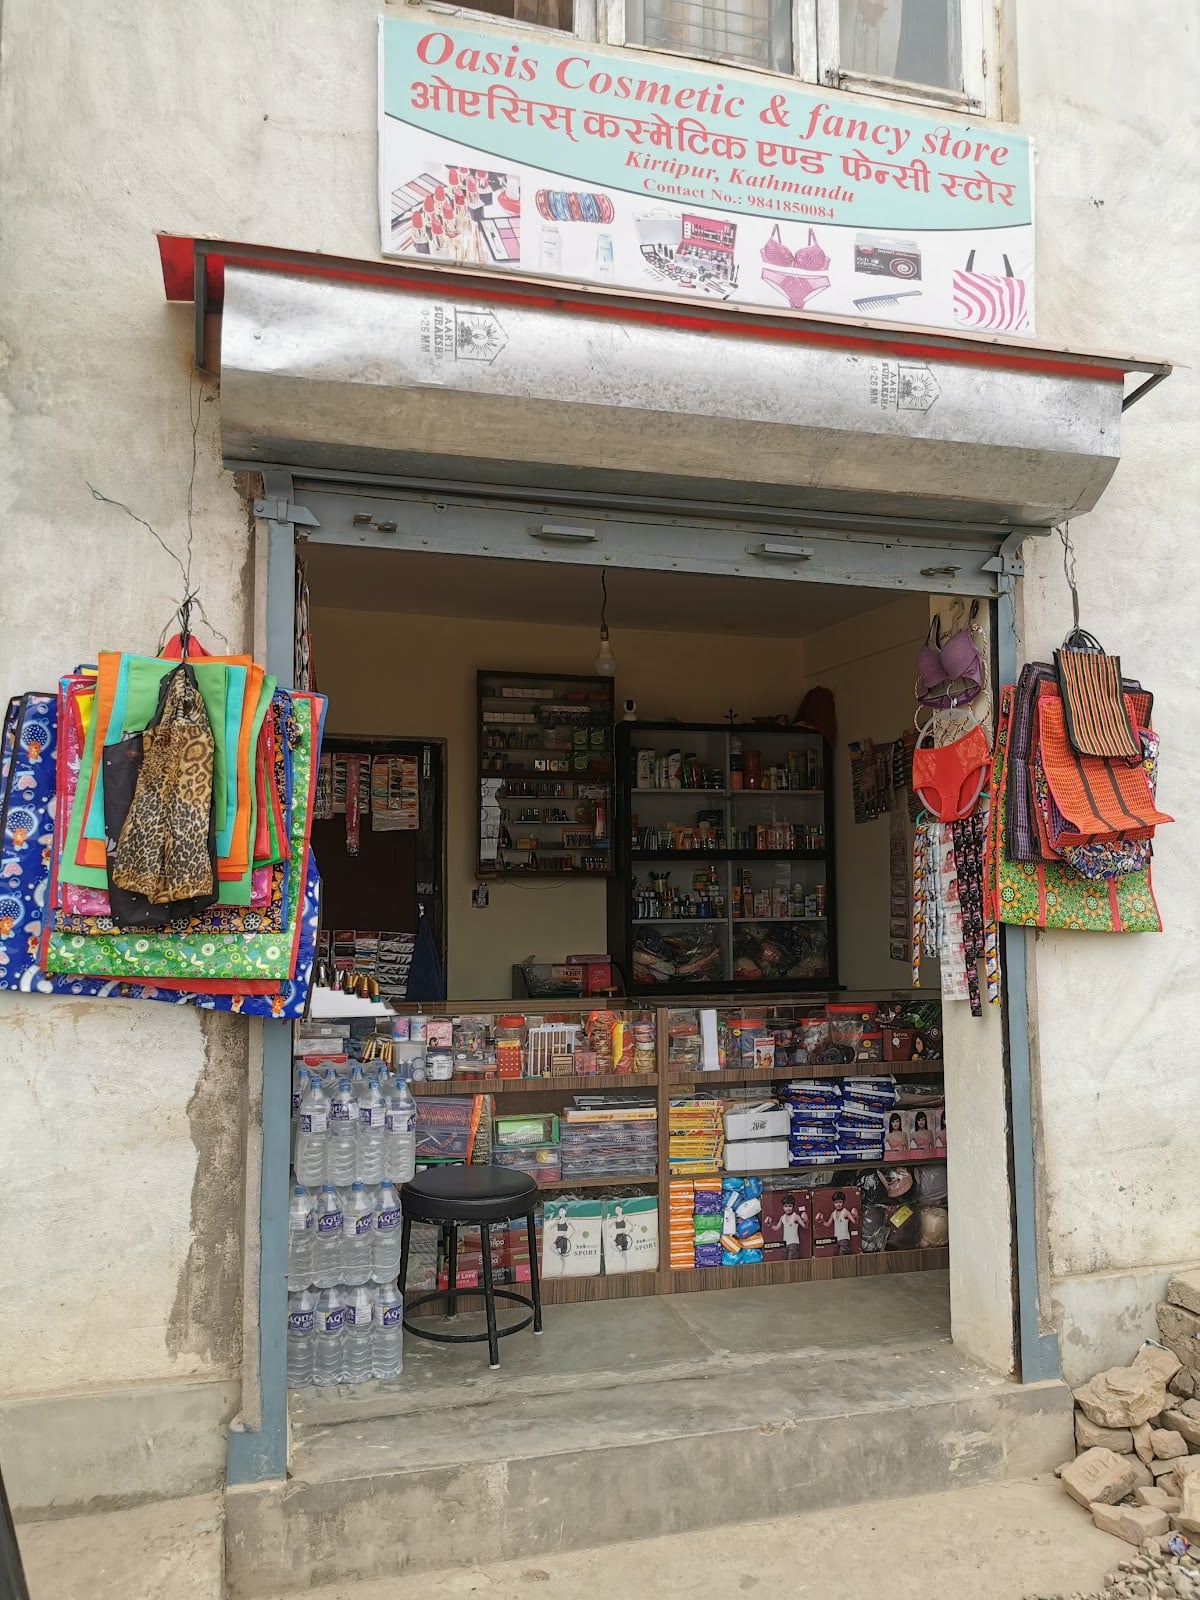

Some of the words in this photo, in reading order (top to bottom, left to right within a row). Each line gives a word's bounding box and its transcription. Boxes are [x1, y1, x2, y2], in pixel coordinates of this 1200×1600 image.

[416, 32, 539, 82] Oasis
[555, 56, 745, 119] Cosmetic
[759, 93, 792, 128] &
[799, 103, 911, 156] fancy
[921, 126, 1009, 166] store
[410, 74, 579, 142] ओएसिस्
[583, 112, 748, 161] कस्मेटिक
[756, 140, 832, 175] एण्ड
[840, 148, 931, 194] फेन्सी
[938, 169, 1017, 207] स्टोर
[624, 150, 720, 184] Kirtipur,
[728, 167, 856, 203] Kathmandu
[643, 177, 705, 199] Contact
[711, 188, 742, 205] No.:
[747, 195, 835, 219] 9841850084
[434, 305, 444, 360] SURAKSHA
[444, 316, 454, 353] AARTI
[881, 362, 890, 410] SURAKSHA
[889, 372, 897, 403] AARTI
[574, 1249, 597, 1257] SPORT
[634, 1242, 657, 1251] SPORT
